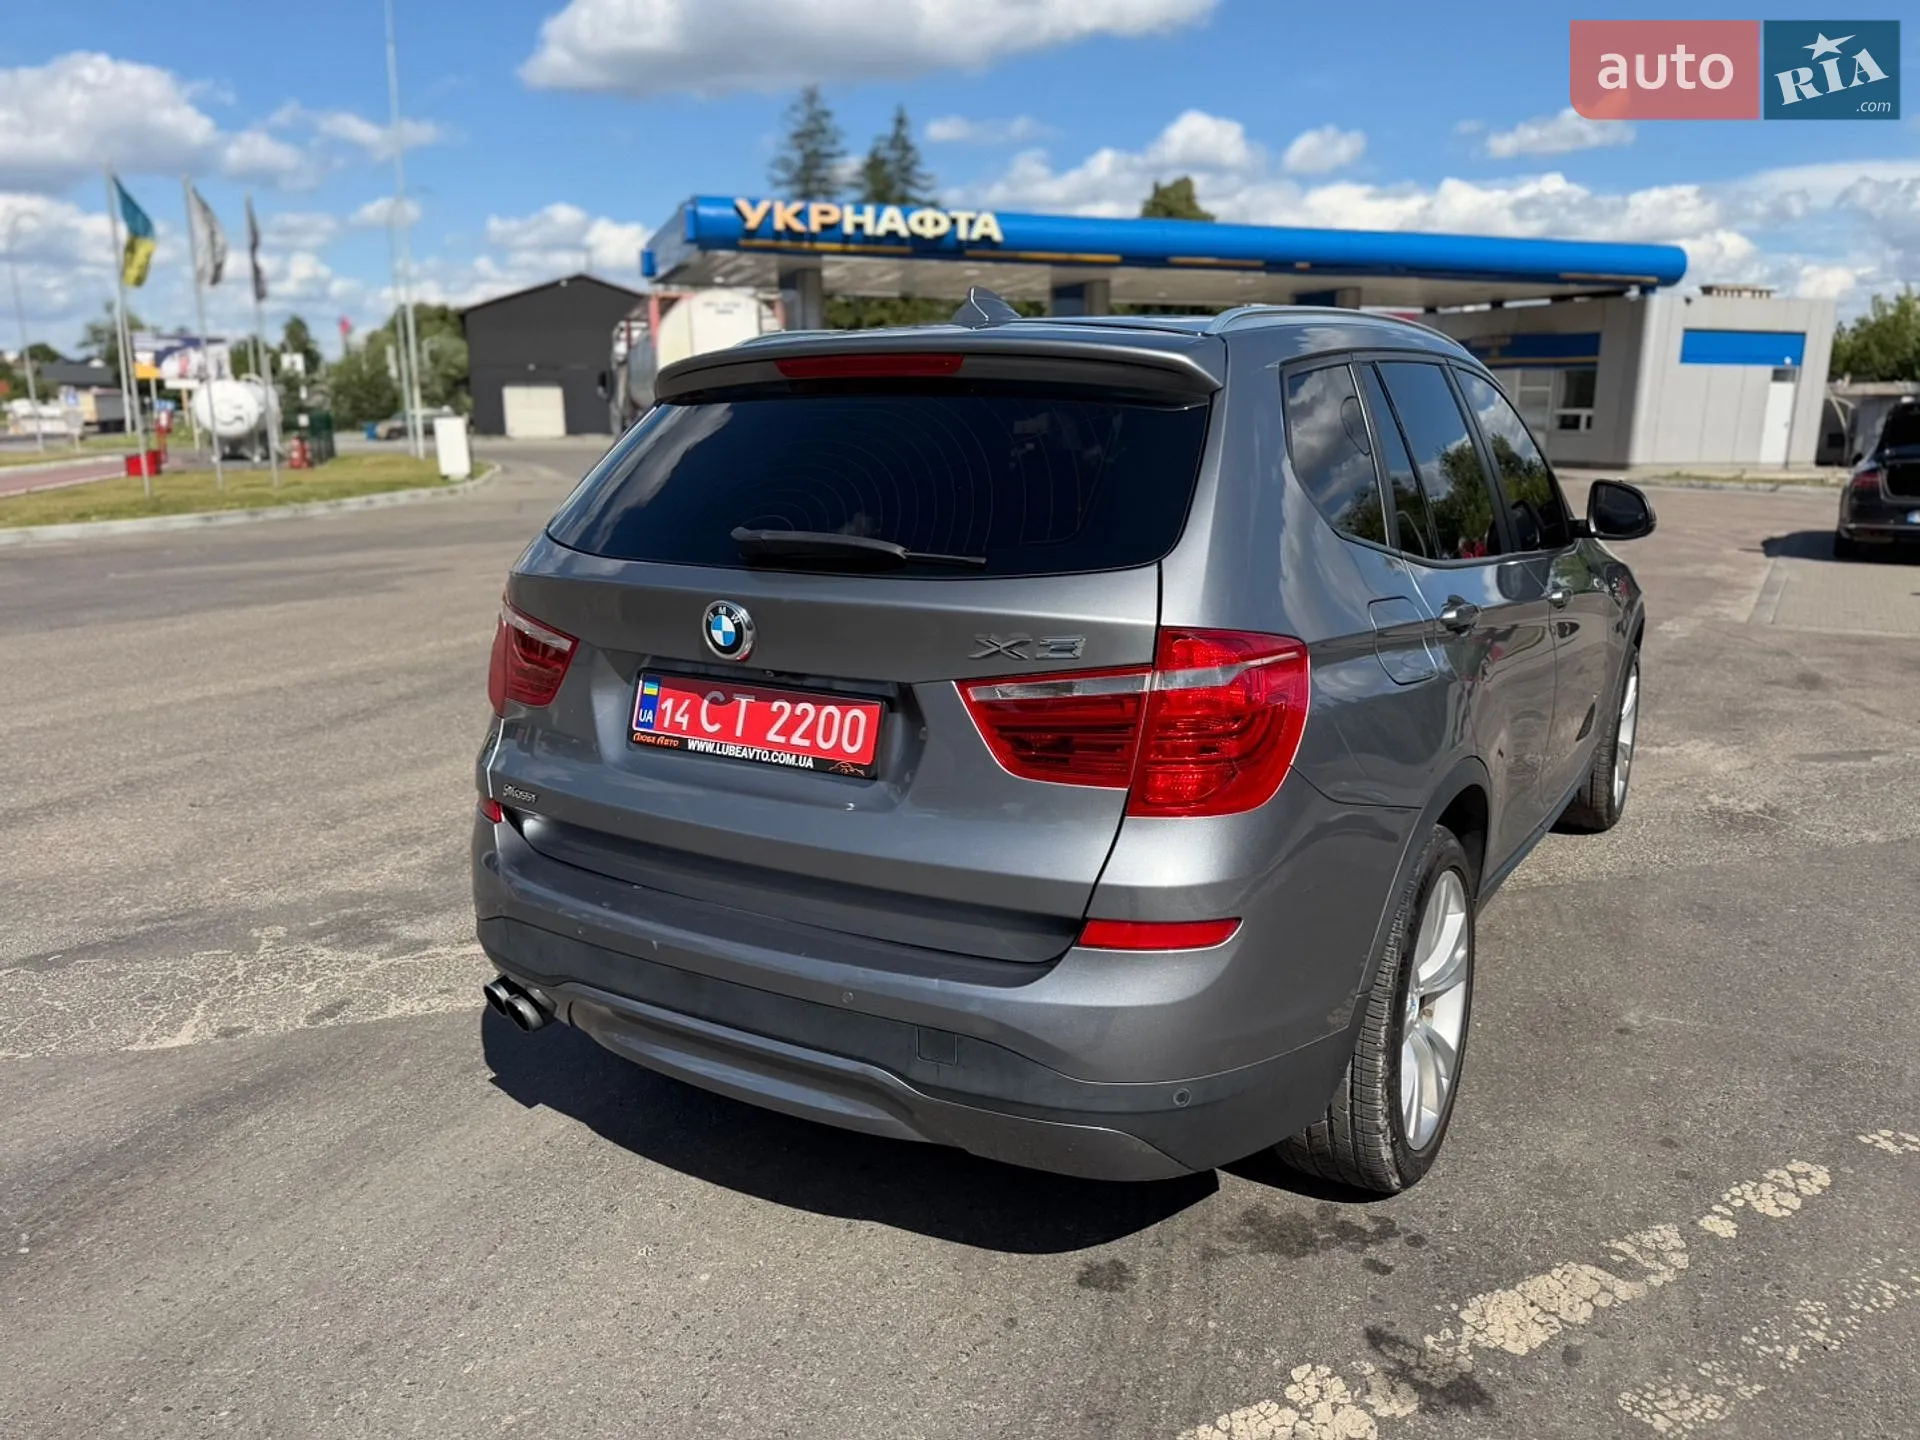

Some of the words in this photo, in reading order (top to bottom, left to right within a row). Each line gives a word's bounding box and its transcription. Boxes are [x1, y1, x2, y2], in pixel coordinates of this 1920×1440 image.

[734, 197, 1004, 243] УКРНАФТА
[967, 633, 1086, 660] X3
[638, 708, 654, 723] UA
[660, 697, 692, 731] 14
[765, 699, 867, 754] 2200
[687, 738, 814, 769] WWW.LUBEAVTO.COM.UA
